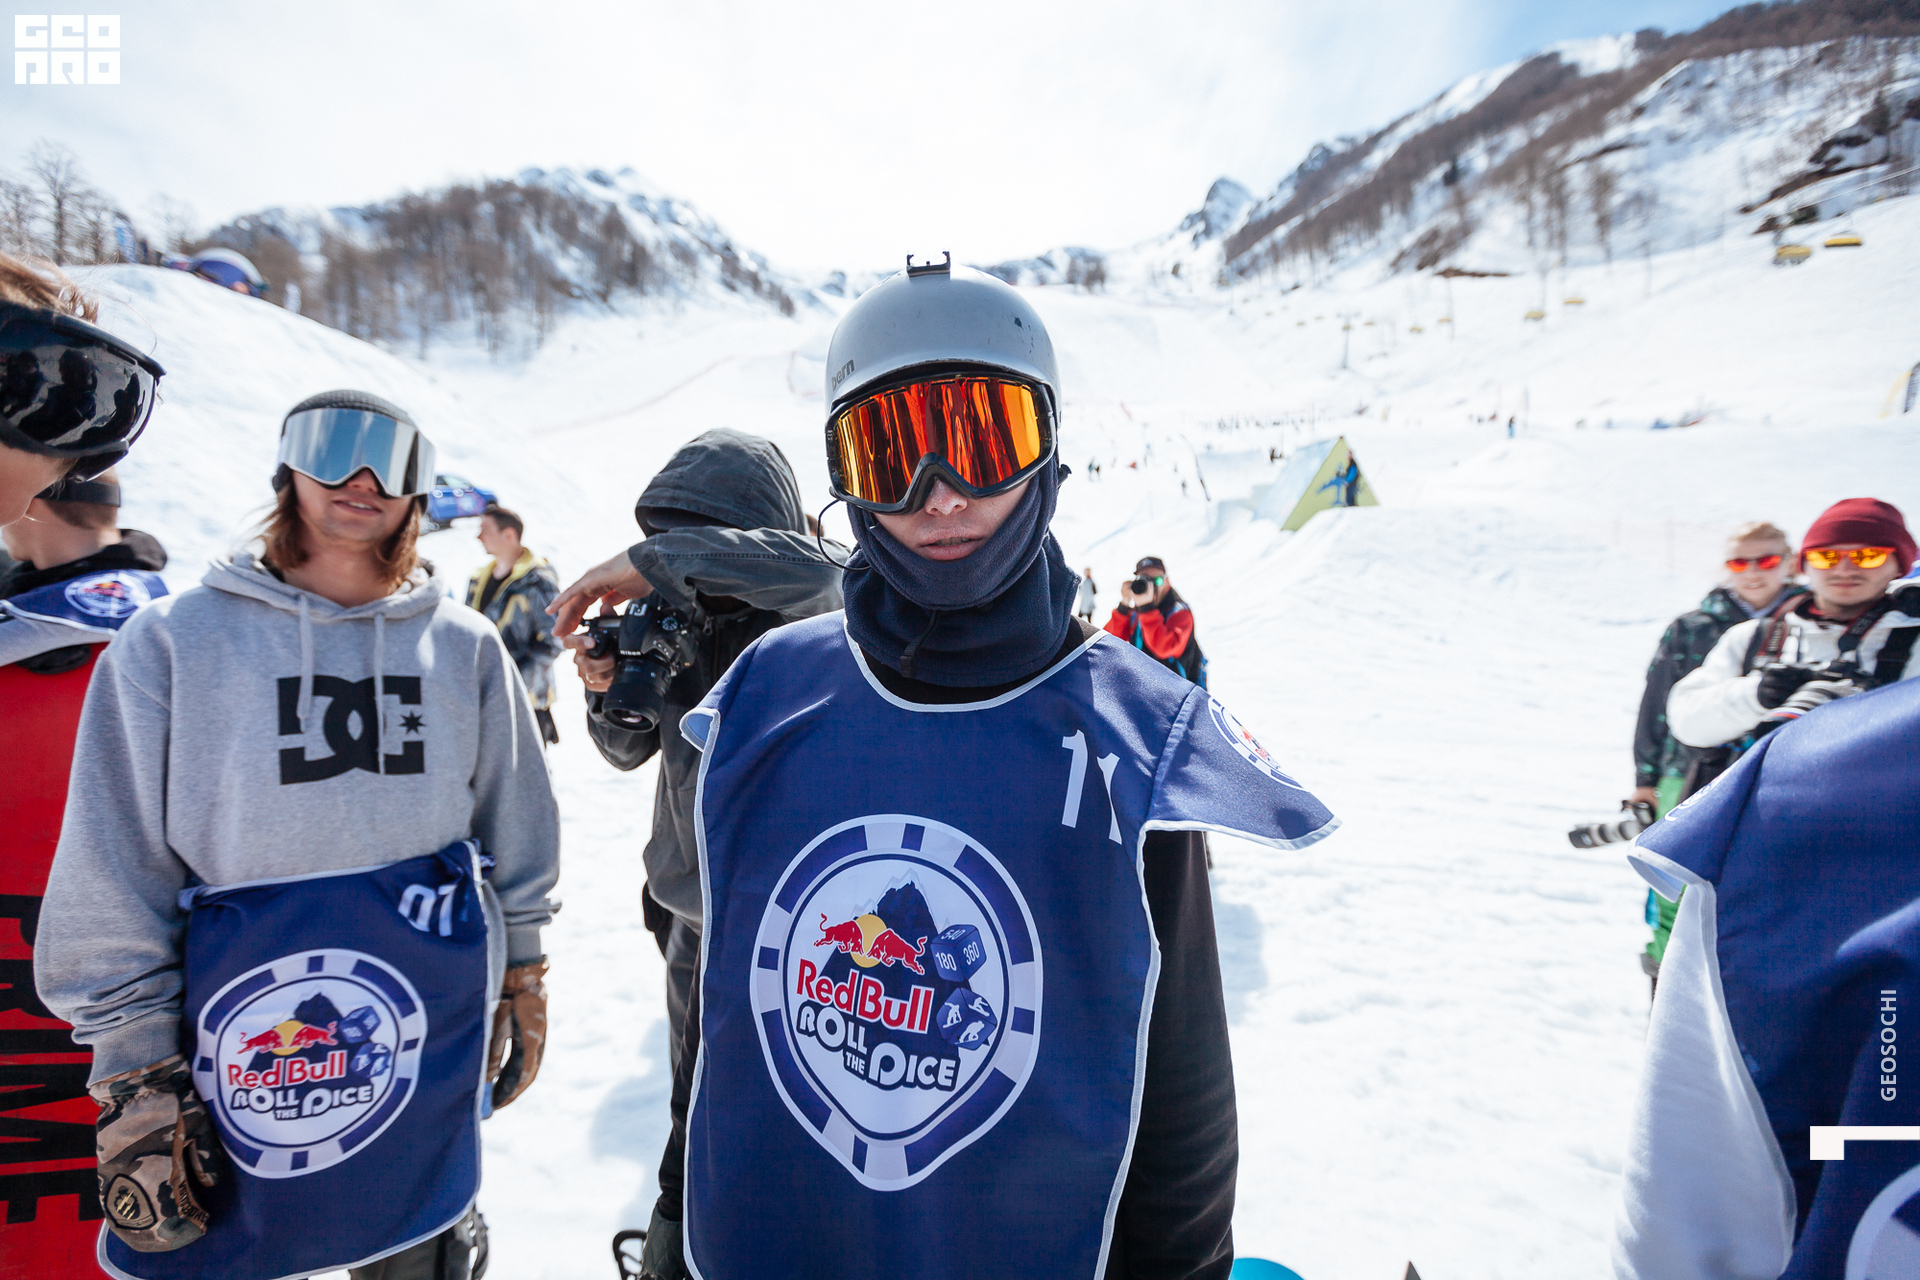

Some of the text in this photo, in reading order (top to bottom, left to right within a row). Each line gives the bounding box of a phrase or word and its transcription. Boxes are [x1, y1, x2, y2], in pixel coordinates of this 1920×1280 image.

[831, 359, 855, 392] bern
[277, 674, 425, 785] DC
[934, 951, 958, 972] 180
[962, 941, 981, 966] 360
[800, 1006, 867, 1055] ROLL
[845, 1052, 866, 1075] THE
[0, 894, 106, 1224] IME
[233, 1088, 299, 1112] ROLL
[275, 1108, 299, 1120] THE
